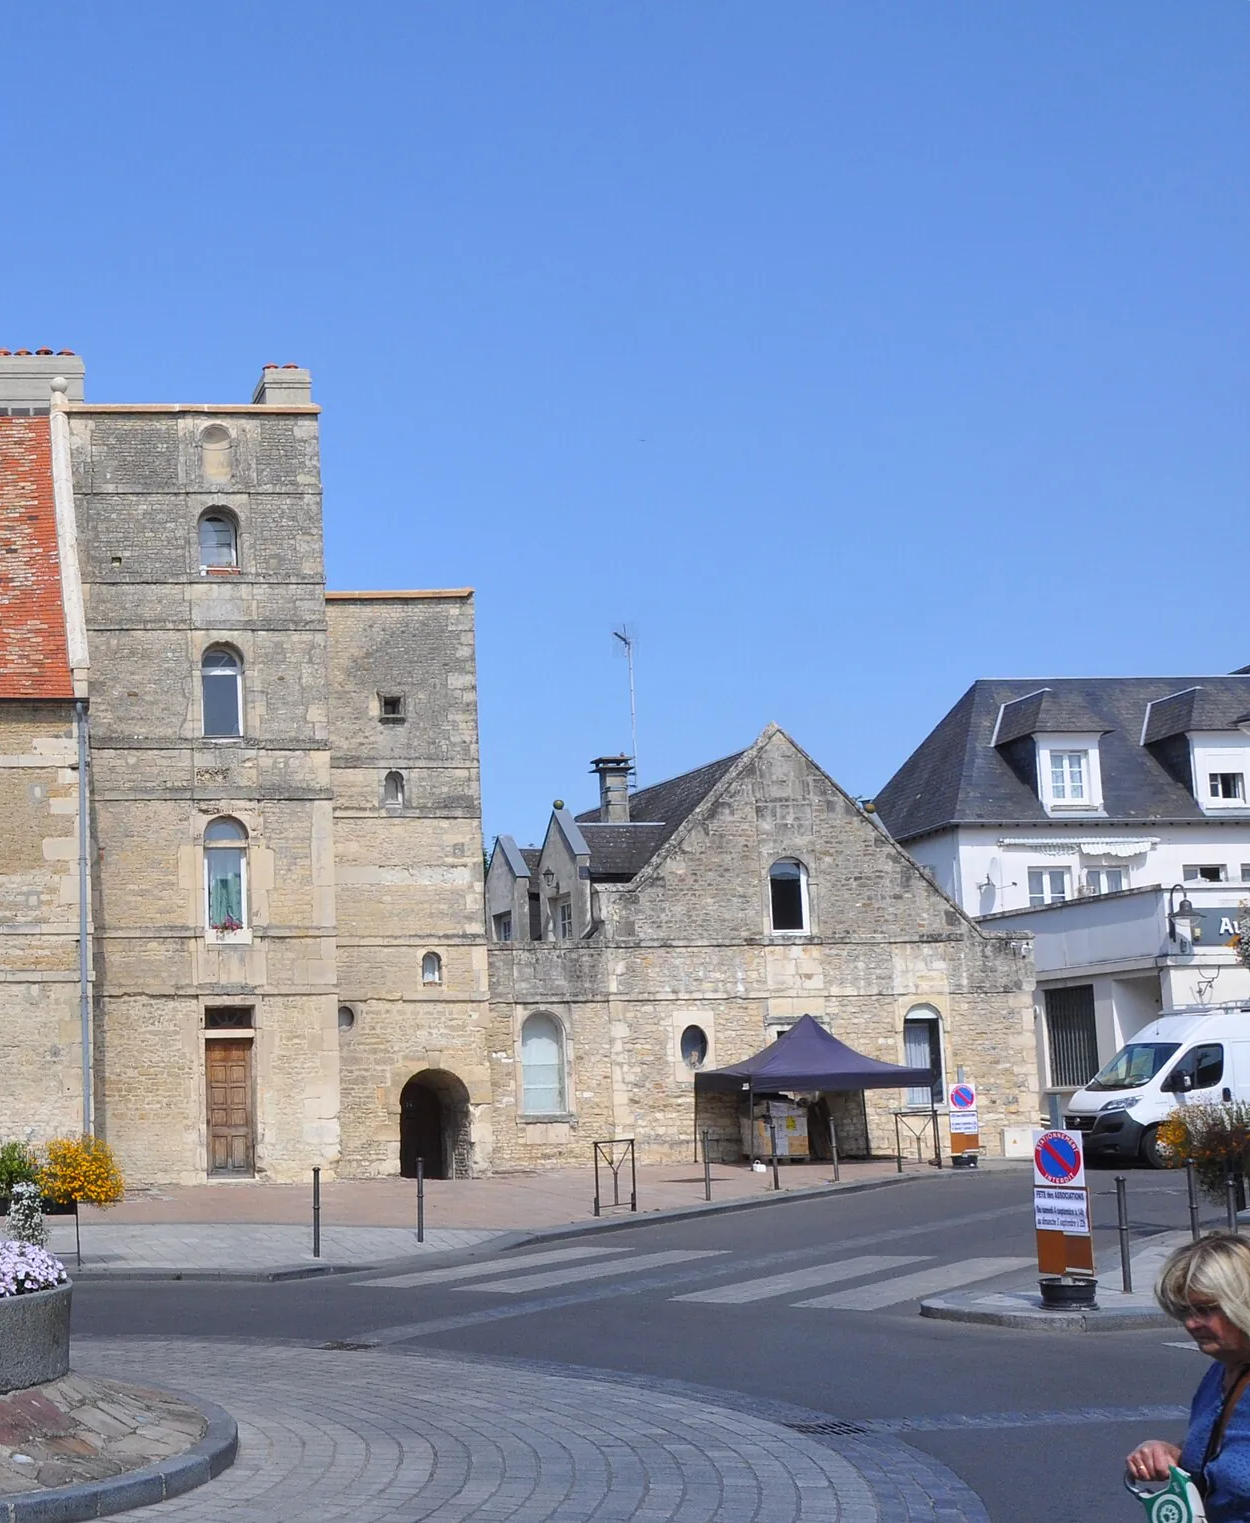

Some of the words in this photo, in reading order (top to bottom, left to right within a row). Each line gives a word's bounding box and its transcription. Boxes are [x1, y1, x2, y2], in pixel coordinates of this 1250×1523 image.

[1036, 1132, 1079, 1152] STATIONNEMENT
[1044, 1172, 1075, 1183] INTERDIT
[1055, 1192, 1084, 1200] ASSOCIATIONS
